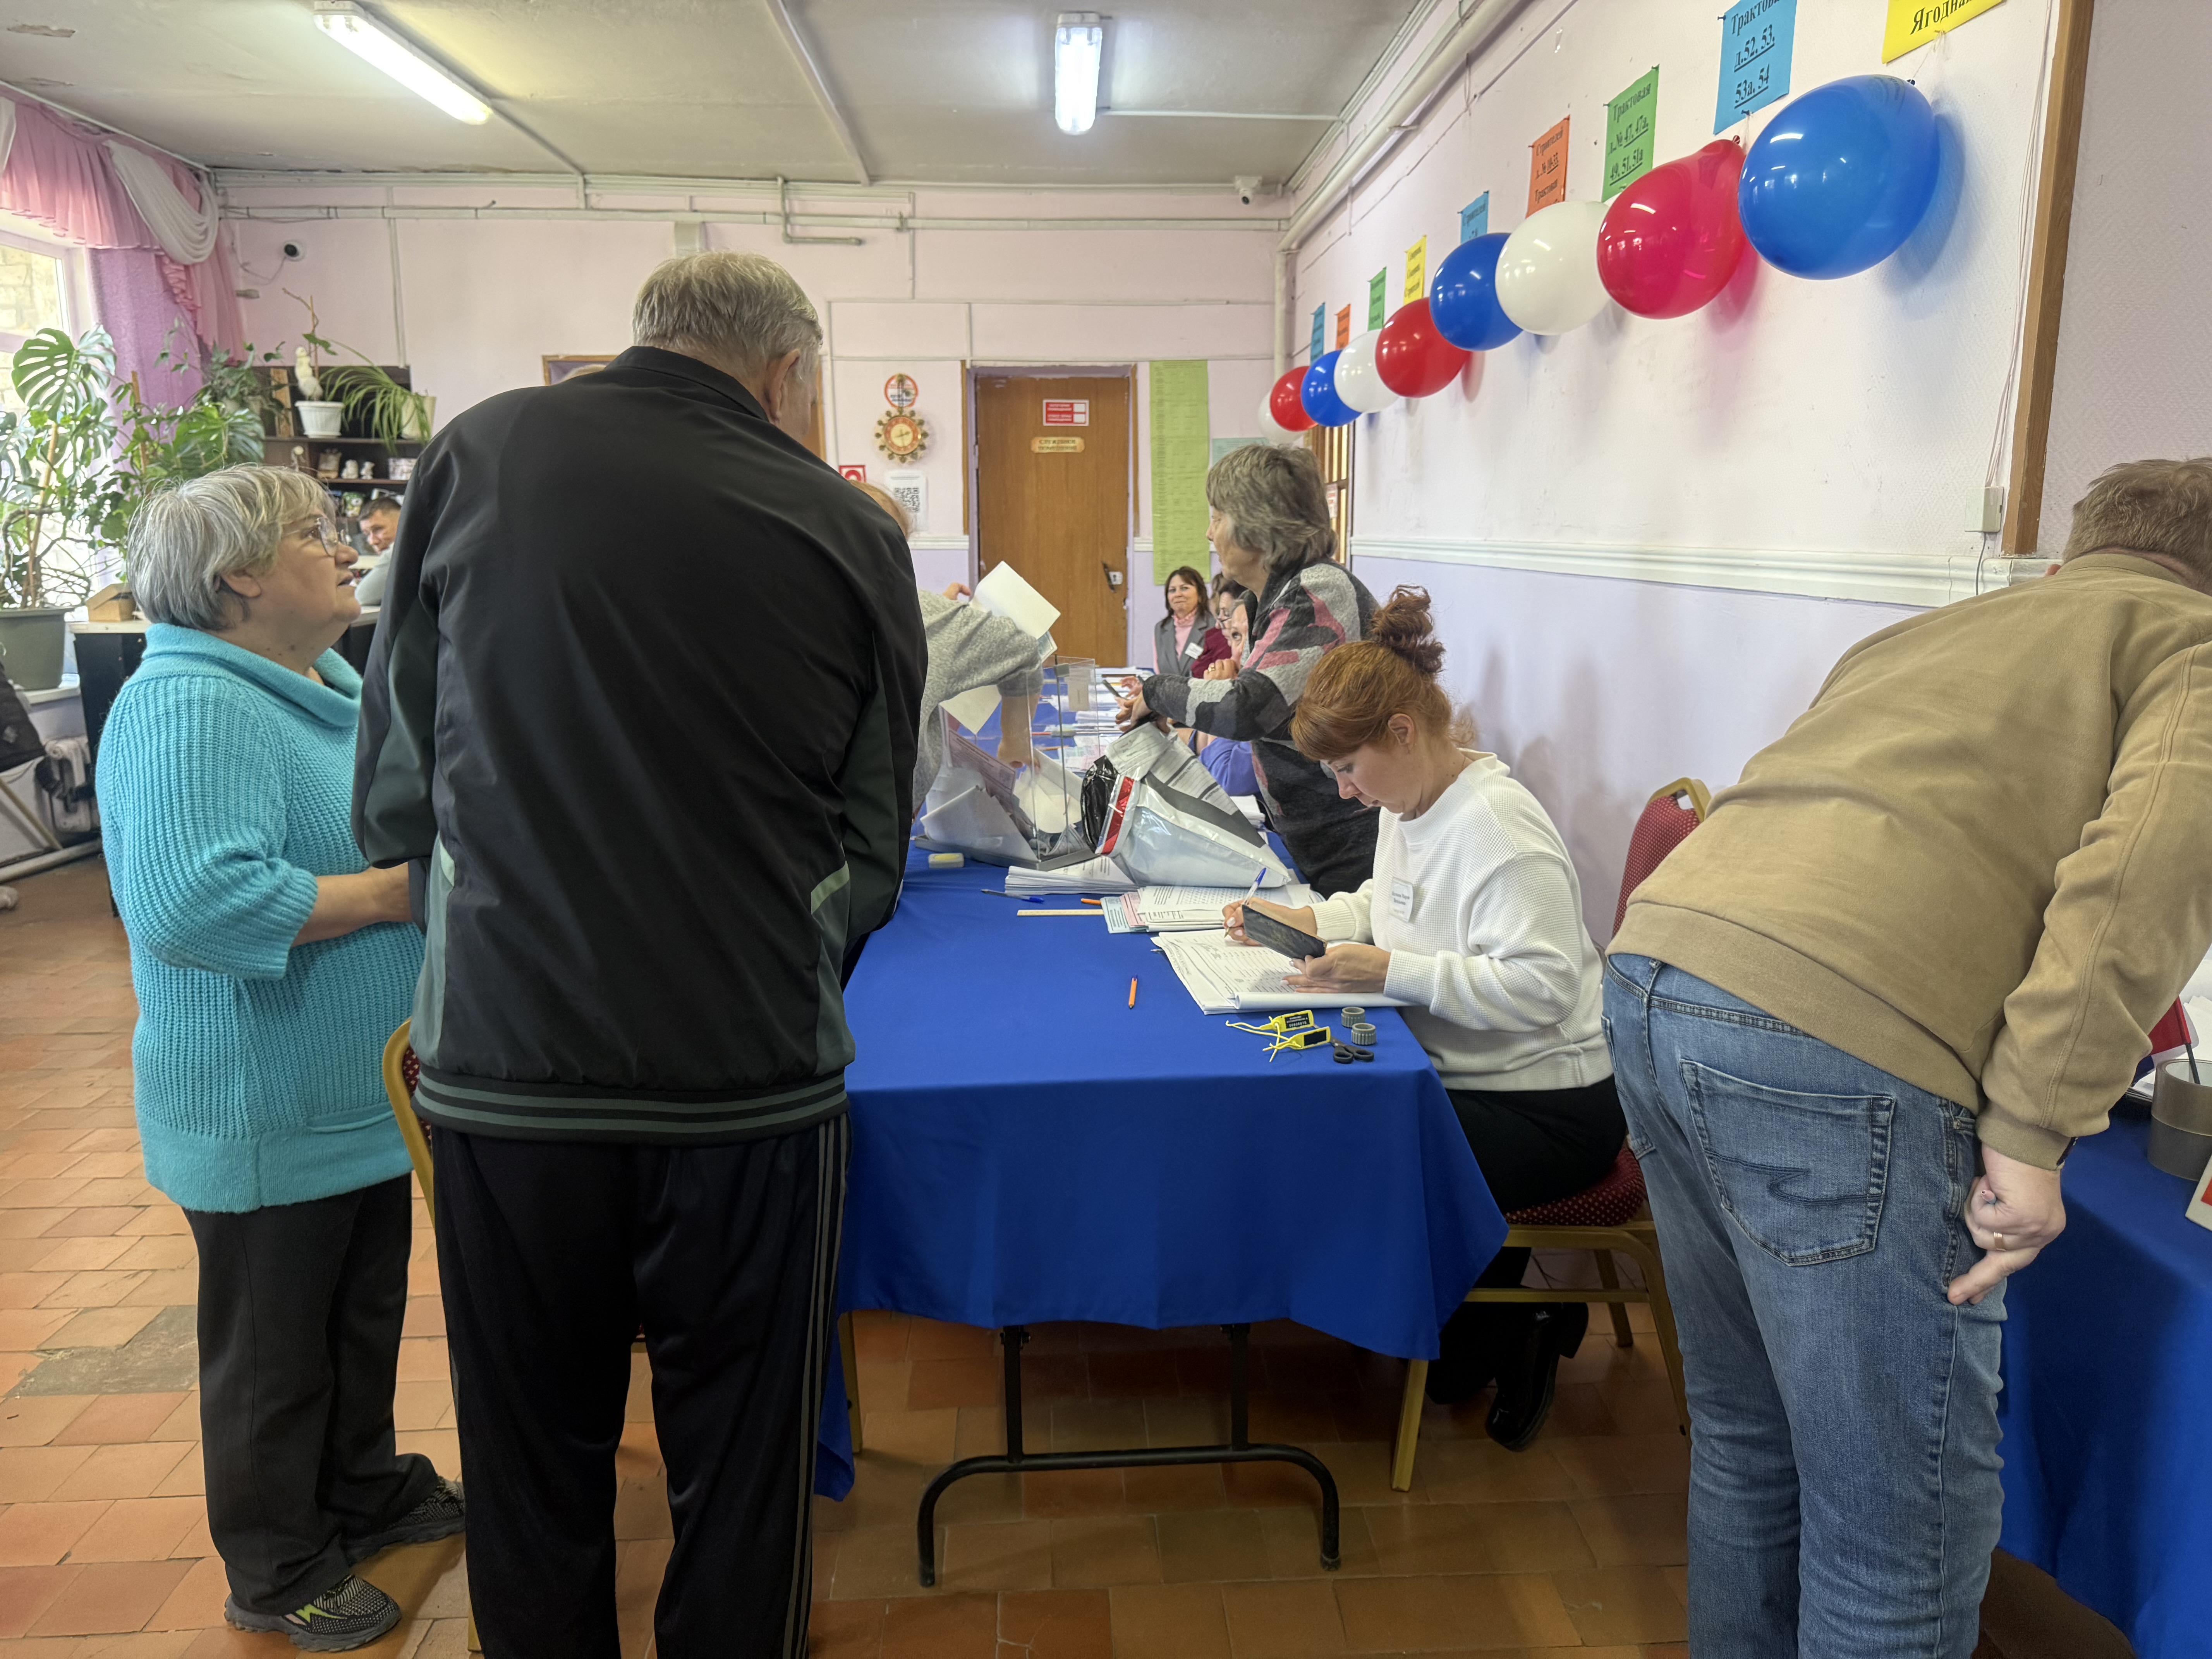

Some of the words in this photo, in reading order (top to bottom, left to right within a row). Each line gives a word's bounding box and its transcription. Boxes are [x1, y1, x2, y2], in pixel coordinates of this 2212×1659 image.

[1731, 0, 1780, 37] Трактов
[1910, 0, 1972, 35] Ягодна
[1758, 64, 1769, 89] 54
[1613, 82, 1651, 123] Трактовая
